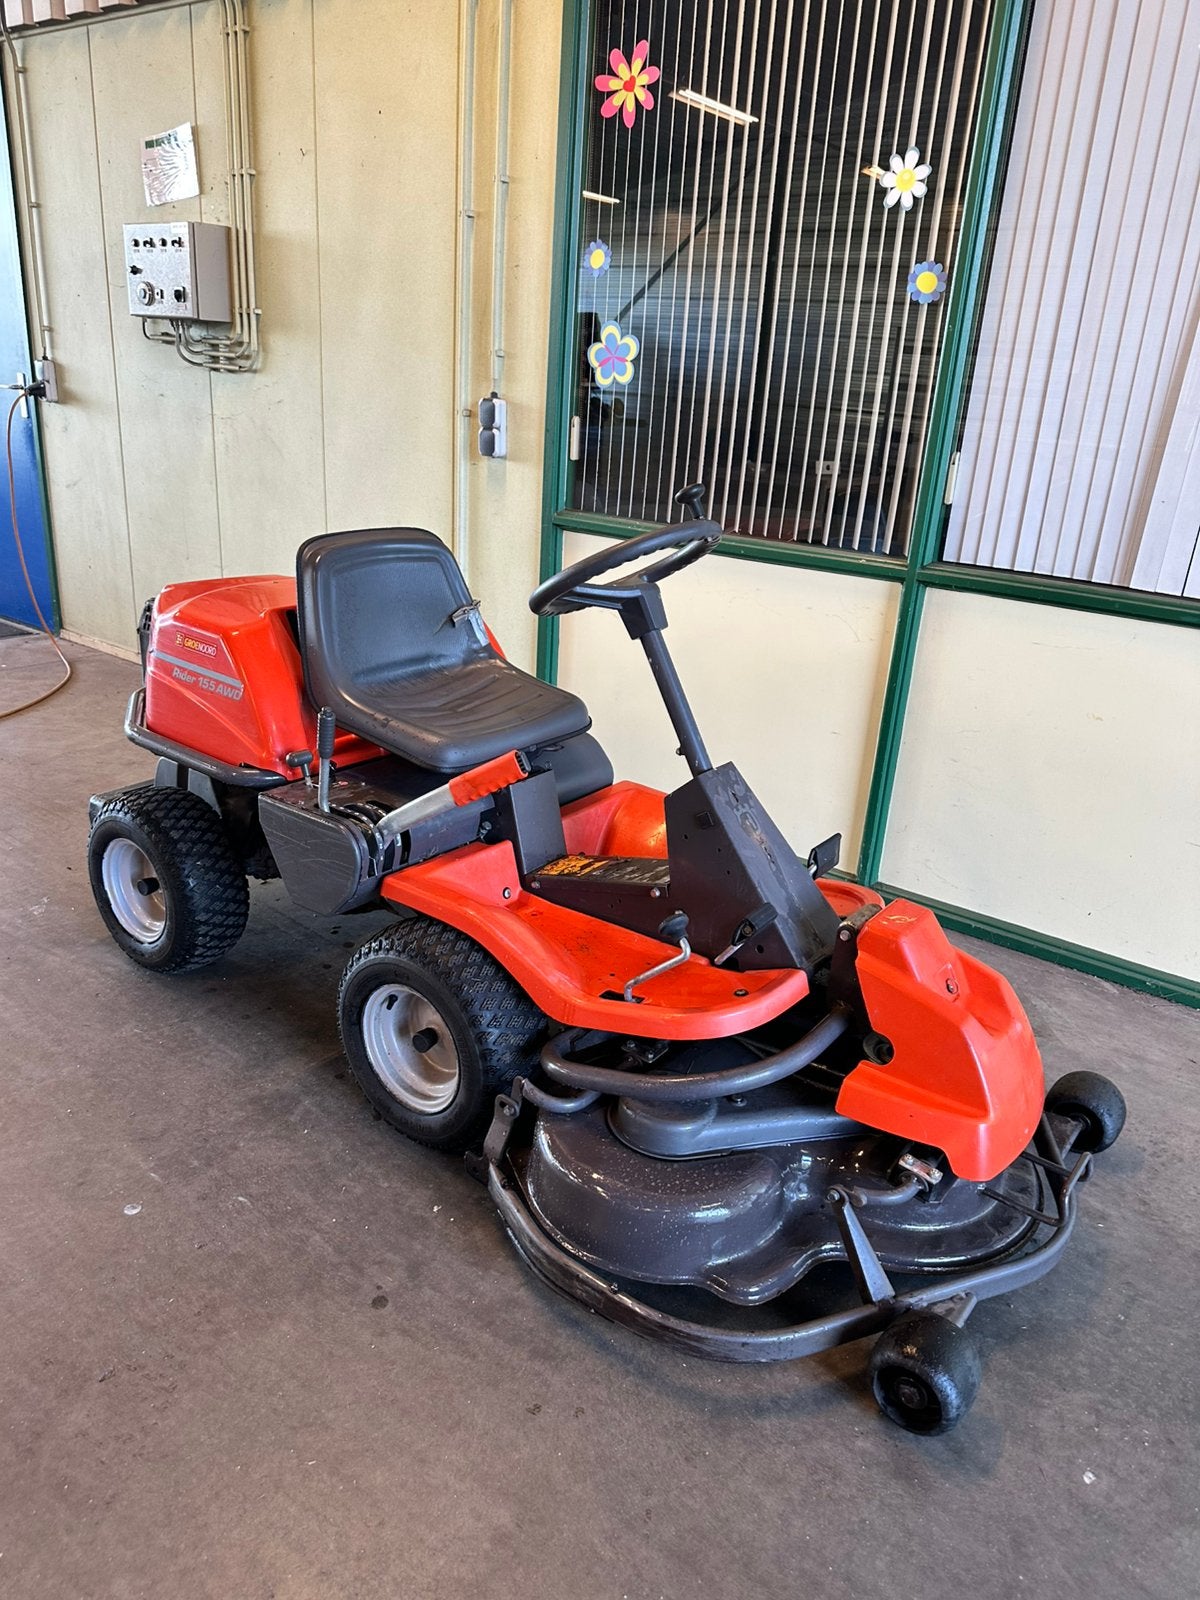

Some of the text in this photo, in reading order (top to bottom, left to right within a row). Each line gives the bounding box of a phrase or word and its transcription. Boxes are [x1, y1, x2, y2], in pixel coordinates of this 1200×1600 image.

[184, 637, 217, 656] GROENOORD
[172, 667, 243, 701] Rider 155 AWD
